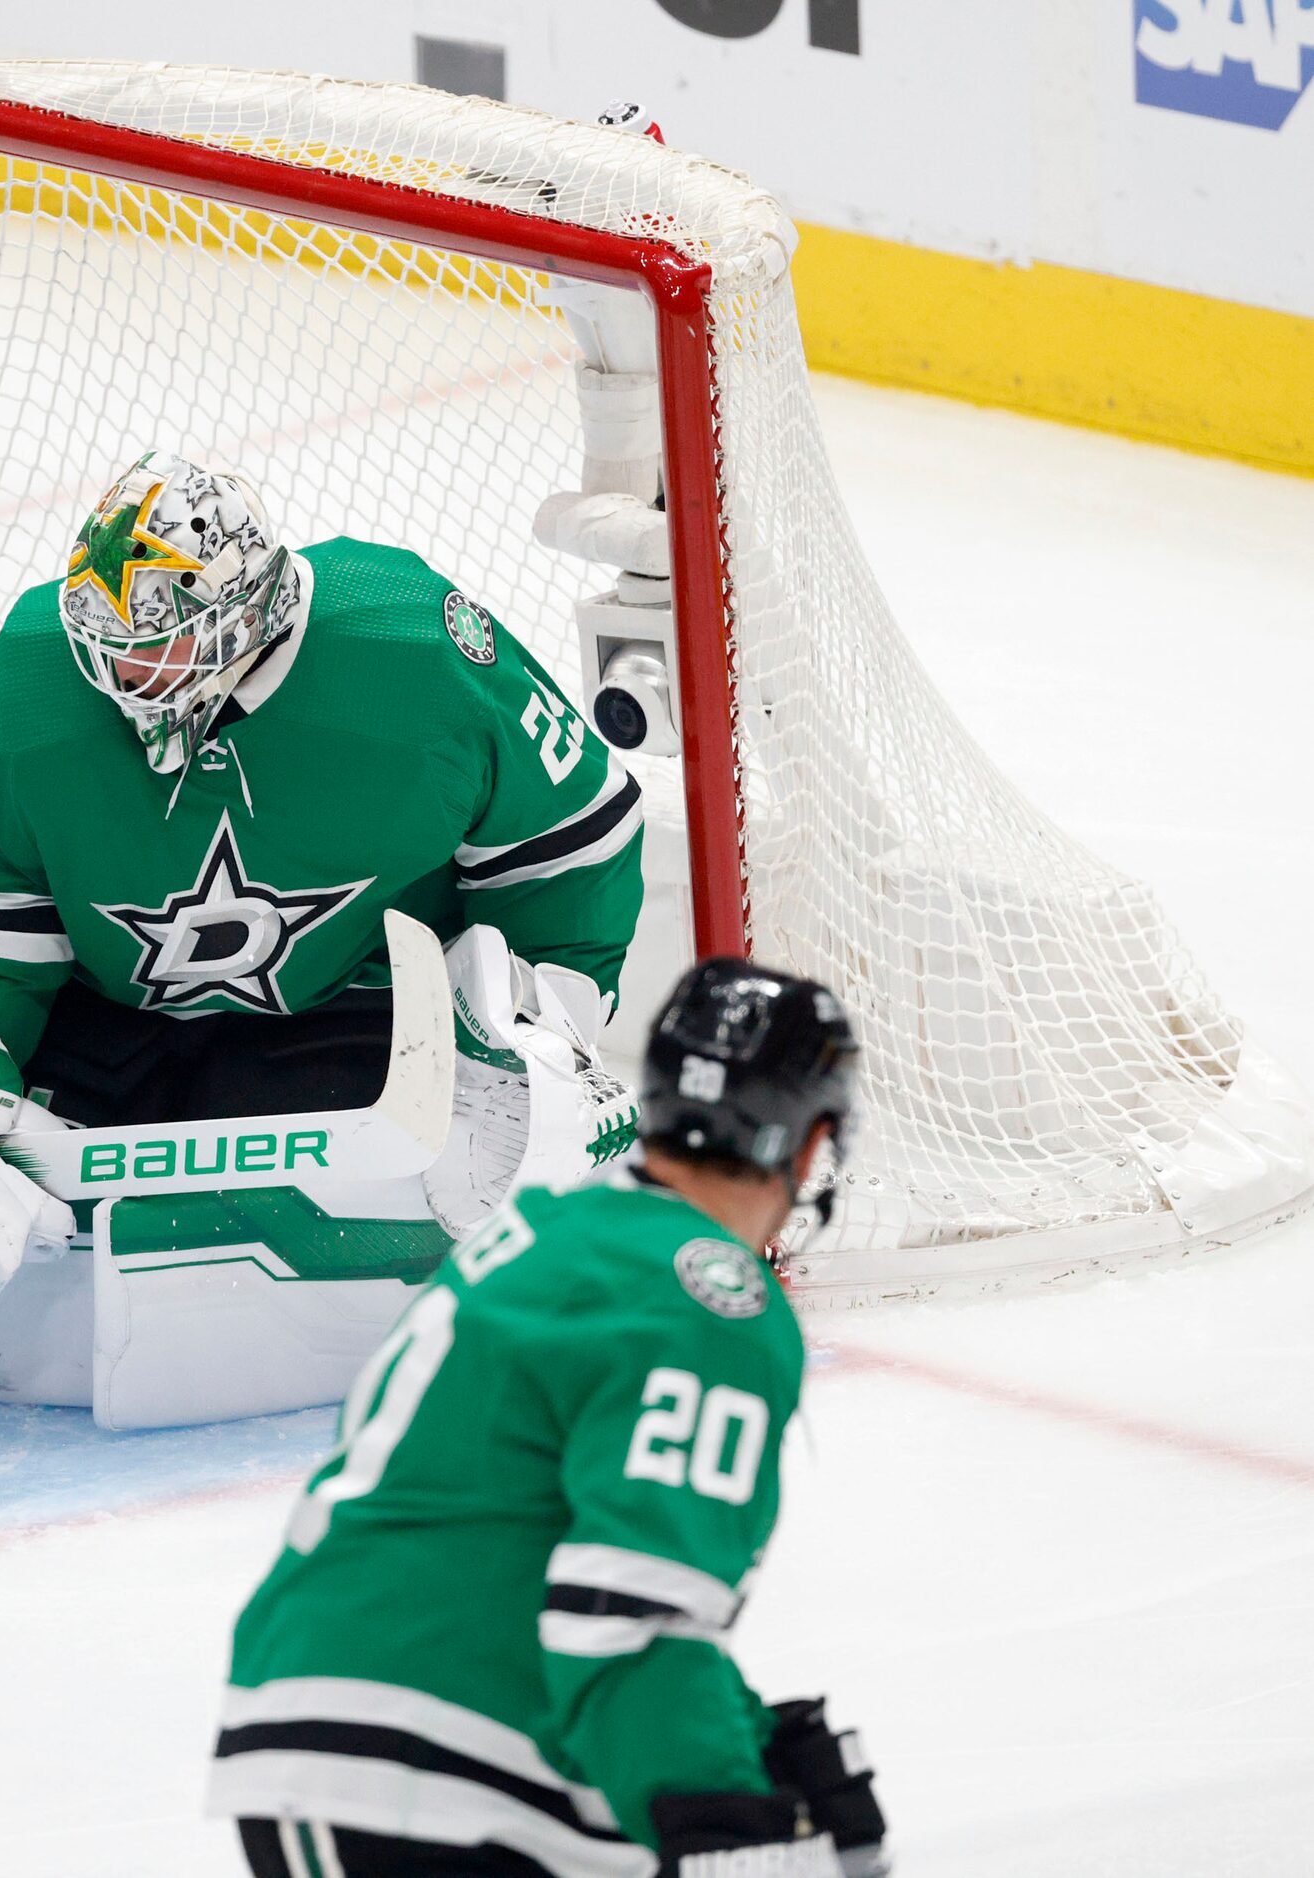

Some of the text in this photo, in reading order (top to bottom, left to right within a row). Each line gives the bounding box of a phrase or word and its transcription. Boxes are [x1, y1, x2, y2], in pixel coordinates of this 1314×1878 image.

[1136, 0, 1314, 92] SAP
[80, 1130, 329, 1184] BAUER
[624, 1366, 770, 1506] 20
